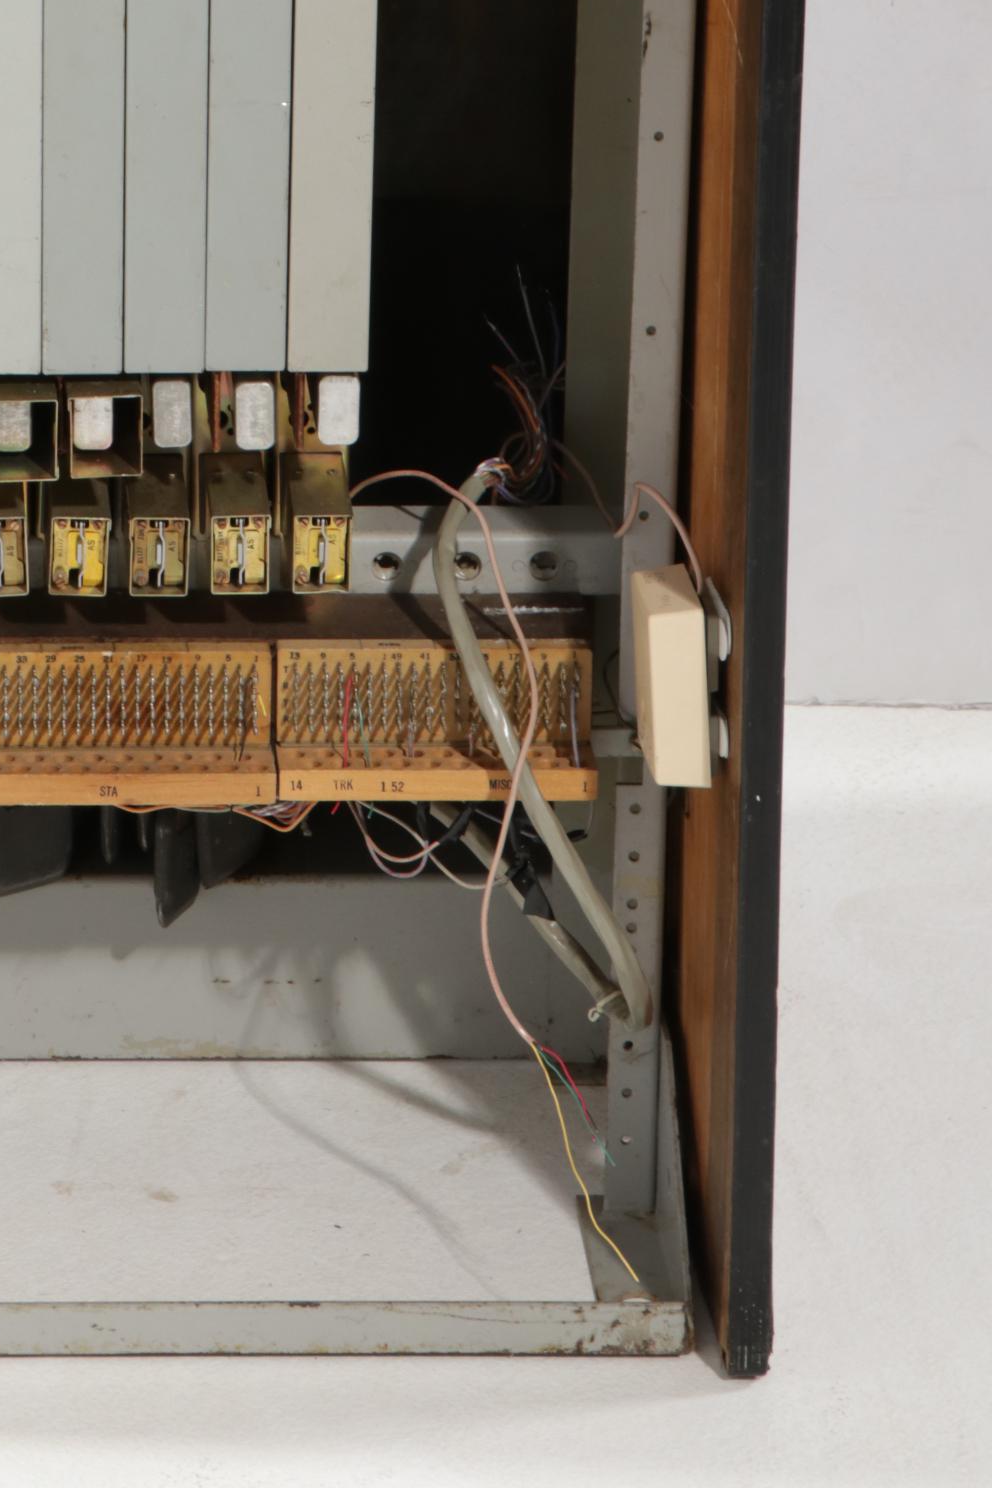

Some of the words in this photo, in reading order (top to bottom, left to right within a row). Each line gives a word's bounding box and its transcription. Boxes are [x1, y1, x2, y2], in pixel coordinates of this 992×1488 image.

[99, 786, 118, 797] STA
[256, 786, 260, 797] 1
[290, 780, 303, 792] 14
[333, 779, 353, 791] TRK
[381, 781, 386, 792] 1
[391, 781, 404, 792] 52
